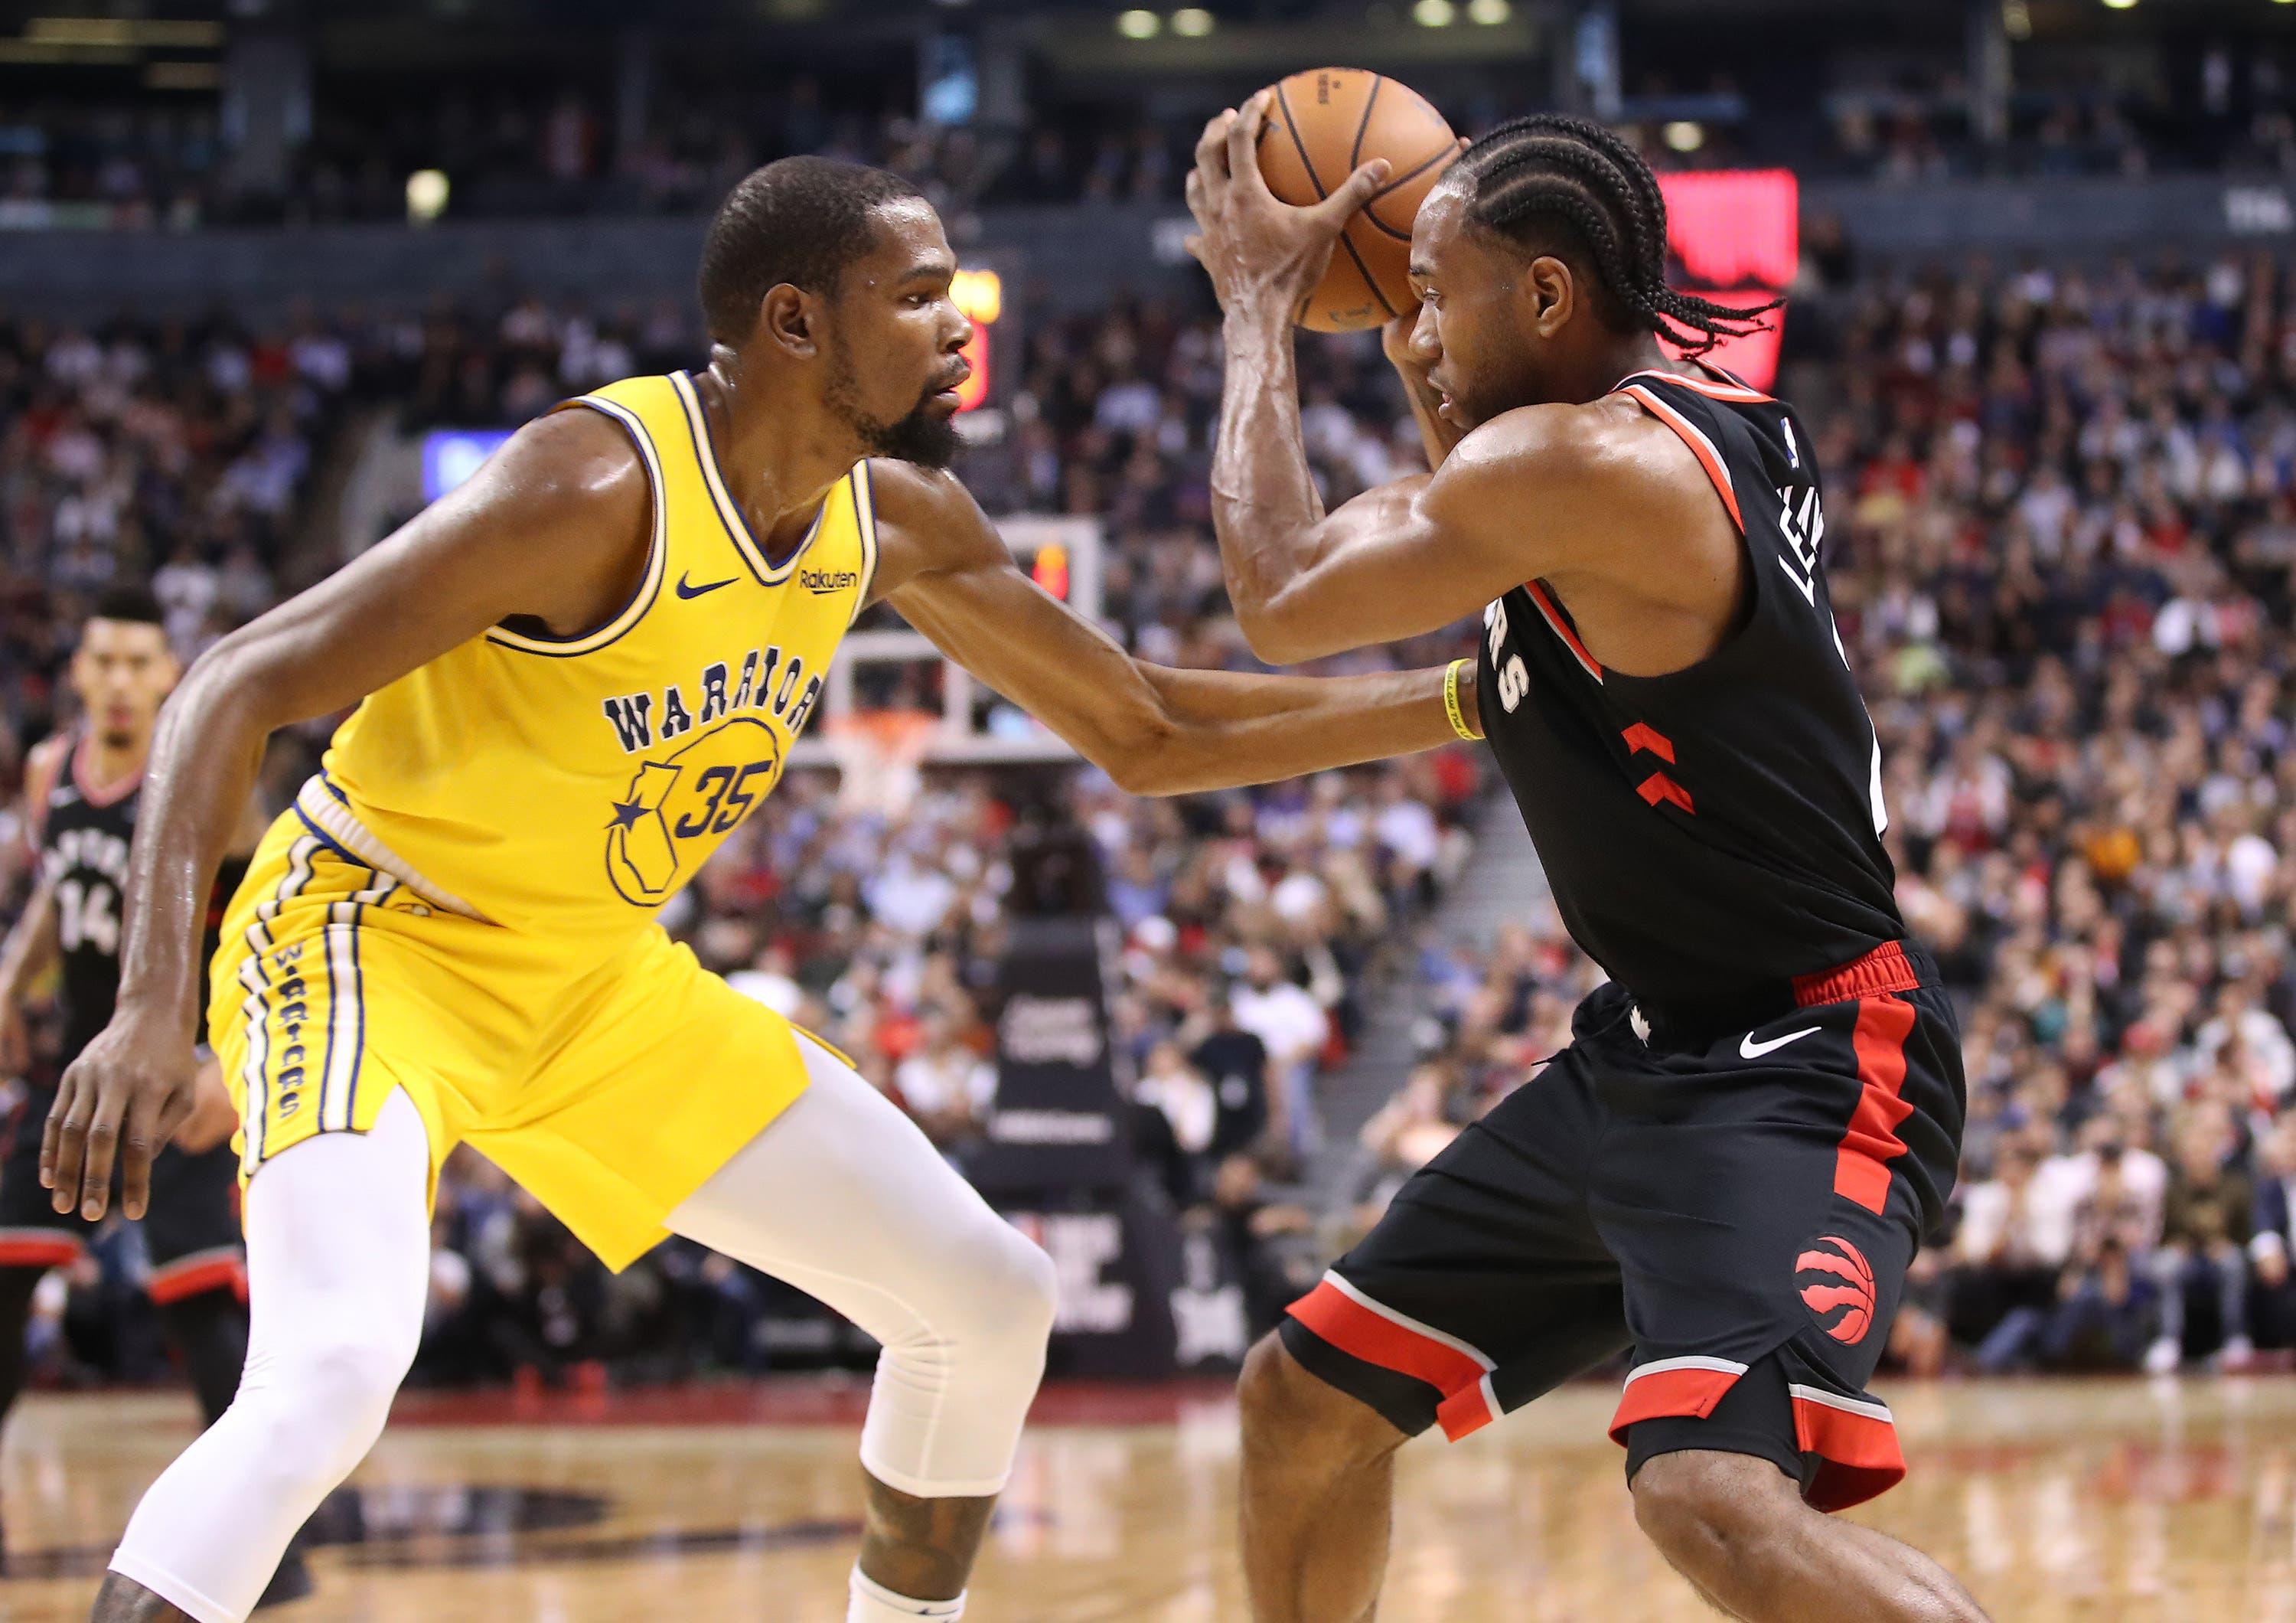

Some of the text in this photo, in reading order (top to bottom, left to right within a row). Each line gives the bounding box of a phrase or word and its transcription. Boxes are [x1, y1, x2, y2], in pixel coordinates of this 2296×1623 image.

[800, 568, 857, 588] Rakuten
[674, 759, 774, 838] 35
[57, 879, 120, 955] 14
